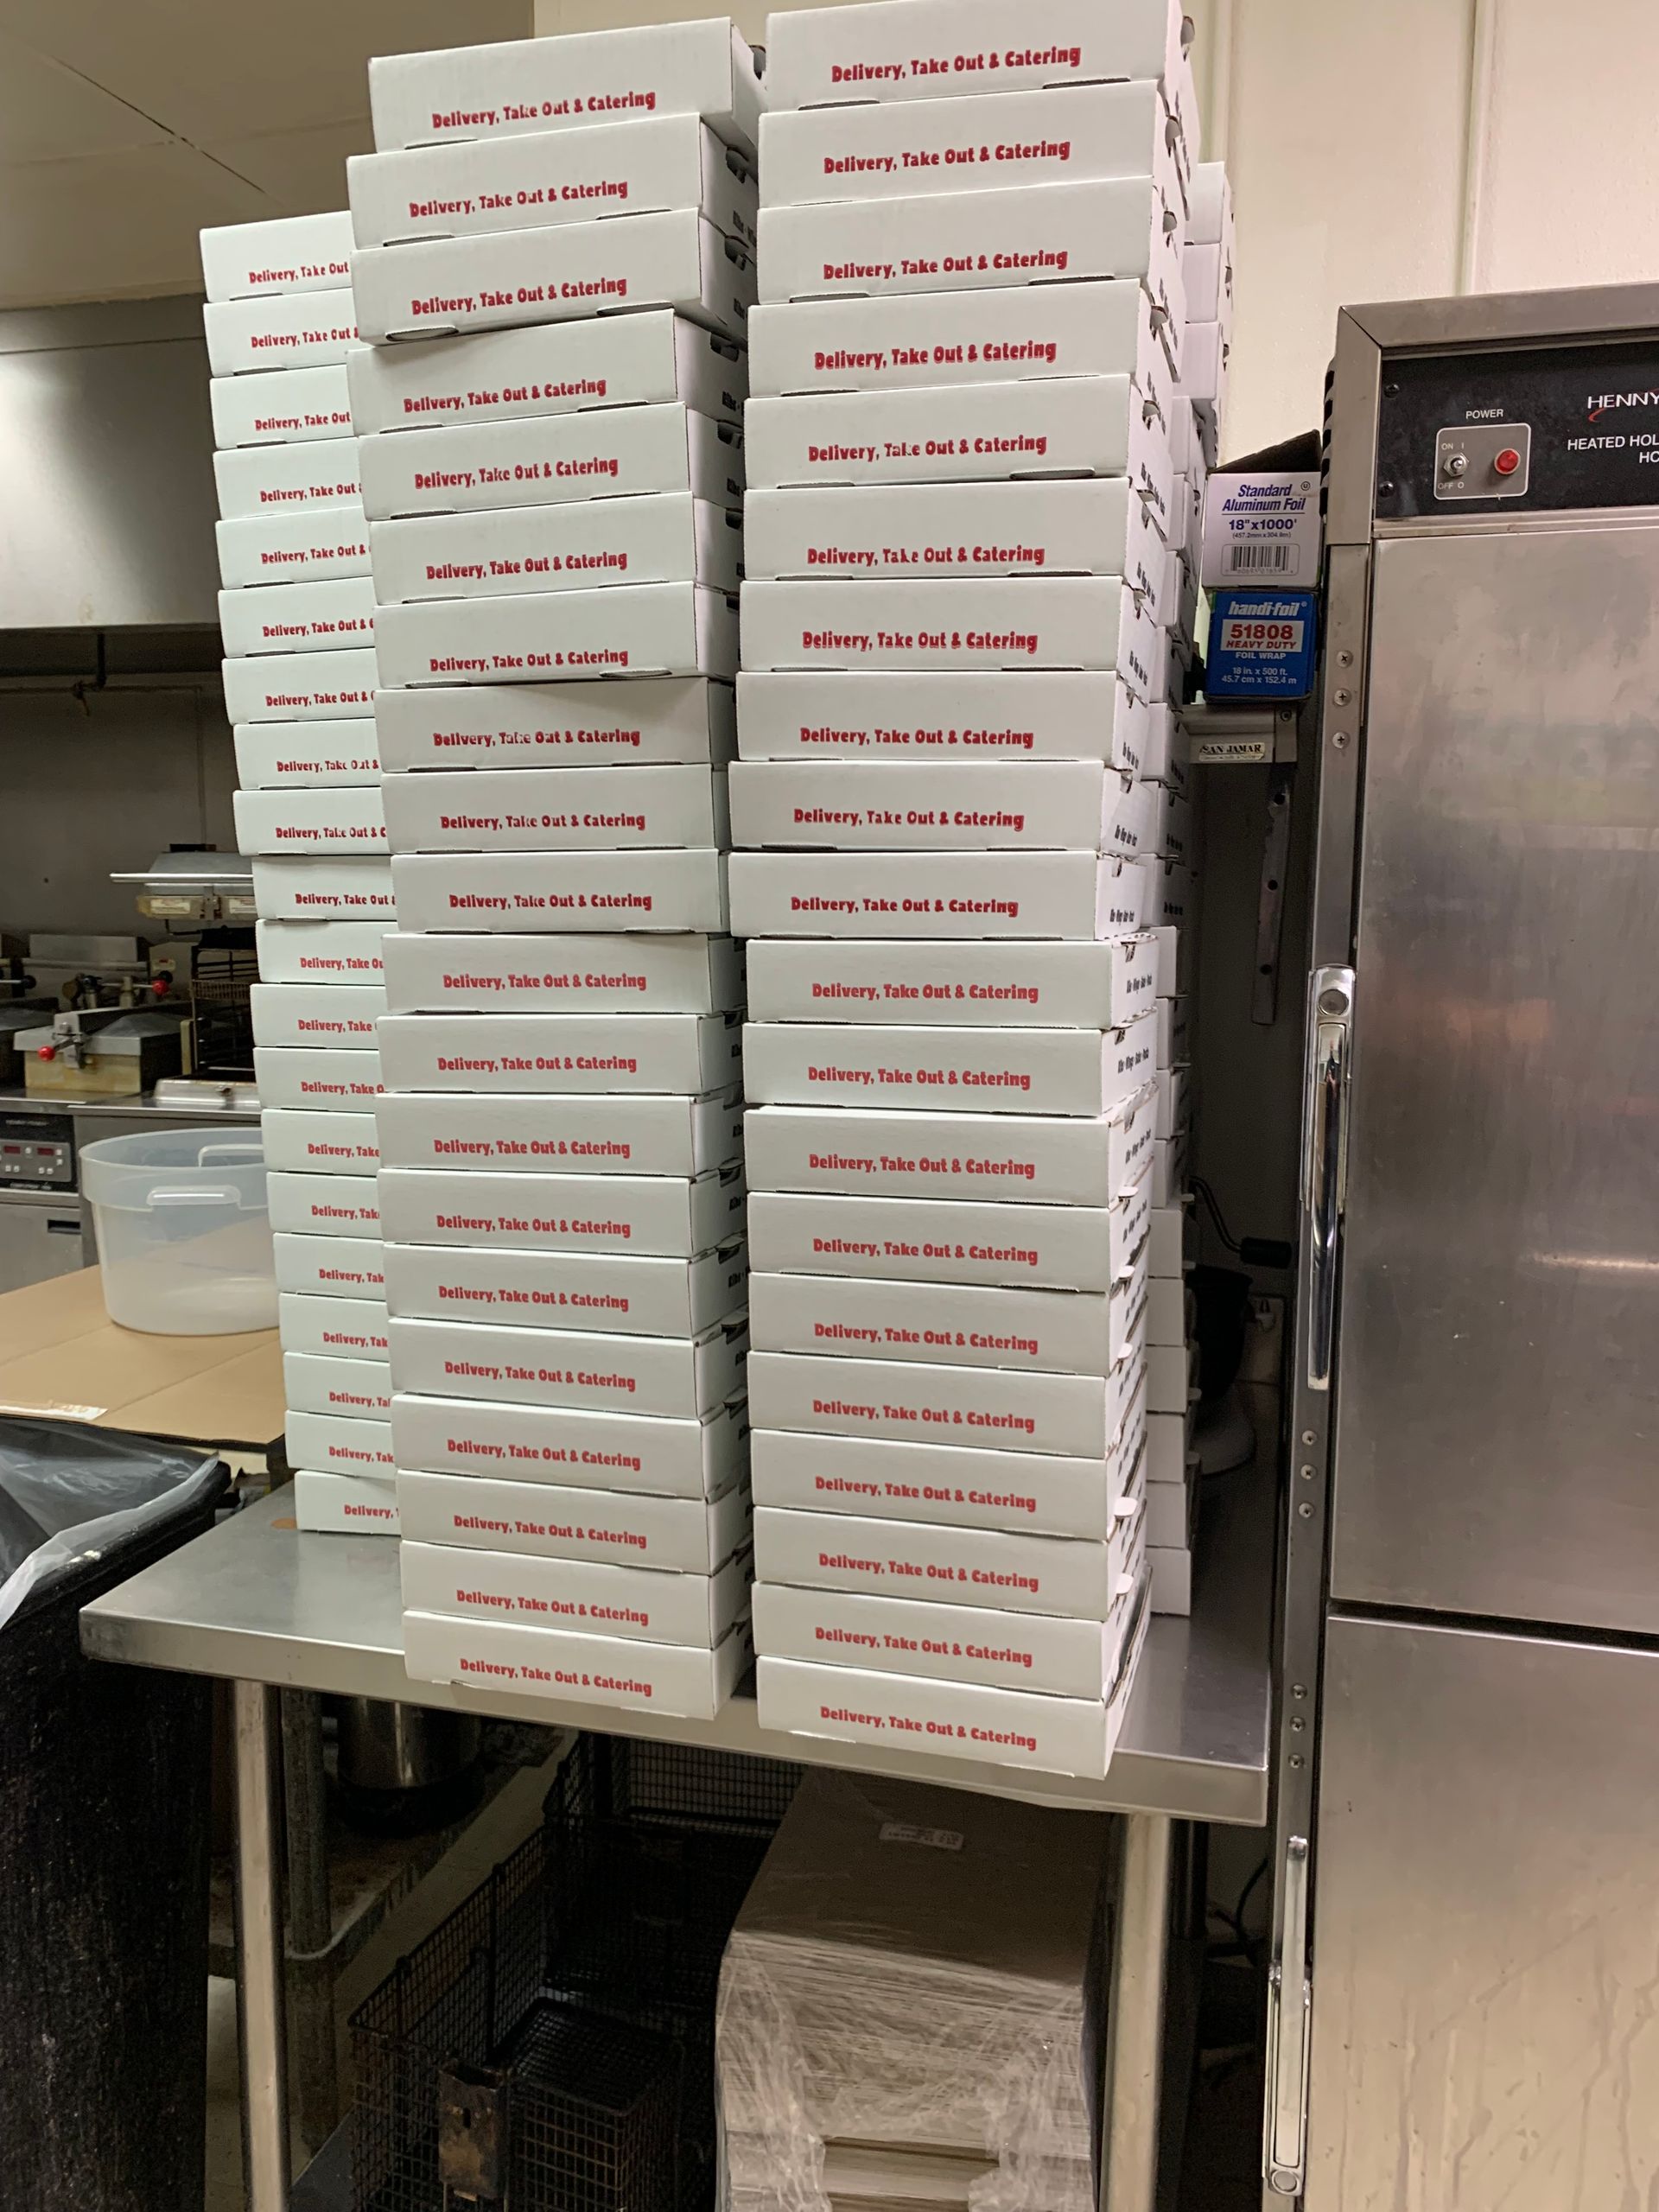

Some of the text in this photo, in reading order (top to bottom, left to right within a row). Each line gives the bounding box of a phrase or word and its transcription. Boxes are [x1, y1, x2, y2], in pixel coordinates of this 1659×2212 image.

[830, 44, 1083, 83] Delivery, Take Out & Catering
[249, 263, 349, 284] Delivery, Take Out
[823, 249, 1069, 281] Delivery, Take Out & Catering
[410, 276, 628, 316] Delivery, Take Out & Catering
[814, 340, 1058, 372] Delivery, Take Out & Catering
[403, 379, 607, 413] Delivery, Take Out & Catering
[254, 413, 351, 431] Delivery, Take Out
[1465, 409, 1503, 419] POWER
[1567, 436, 1625, 451] HEATED
[1238, 484, 1293, 497] Standard
[1222, 498, 1306, 512] Aluminum Foil
[262, 544, 365, 564] Delivery, Take Out &
[1230, 624, 1294, 639] 51808
[802, 630, 1039, 656] Delivery, Take Out & Catering
[1266, 641, 1297, 650] DUTY
[429, 650, 629, 672] Delivery, Take Out & Catering
[1265, 676, 1287, 684] 152.4
[265, 691, 368, 706] Delivery, Take Out &
[1227, 744, 1262, 753] JAMAR
[793, 808, 1025, 832] Delivery, Take Out & Catering
[442, 972, 647, 992] Delivery, Take Out & Catering
[811, 982, 1039, 1005] Delivery, Take Out & Catering
[297, 1019, 372, 1033] Delivery, Take
[307, 1143, 353, 1157] Delivery,
[434, 1139, 632, 1160] Delivery, Take Out & Catering
[808, 1153, 1036, 1180] Delivery, Take Out & Catering
[318, 1268, 363, 1282] Delivery,
[438, 1286, 629, 1313] Delivery, Take Out & Catering
[814, 1322, 1039, 1356] Delivery, Take Out & Catering
[328, 1391, 373, 1407] Delivery,
[328, 1446, 372, 1462] Delivery,
[446, 1438, 642, 1472] Delivery, Take Out & Catering
[815, 1475, 1037, 1515] Delivery, Take Out & Catering
[453, 1514, 648, 1550] Delivery, Take Out & Catering
[815, 1626, 1034, 1669] Delivery, Take Out & Catering
[459, 1658, 654, 1699] Delivery, Take Out & Catering
